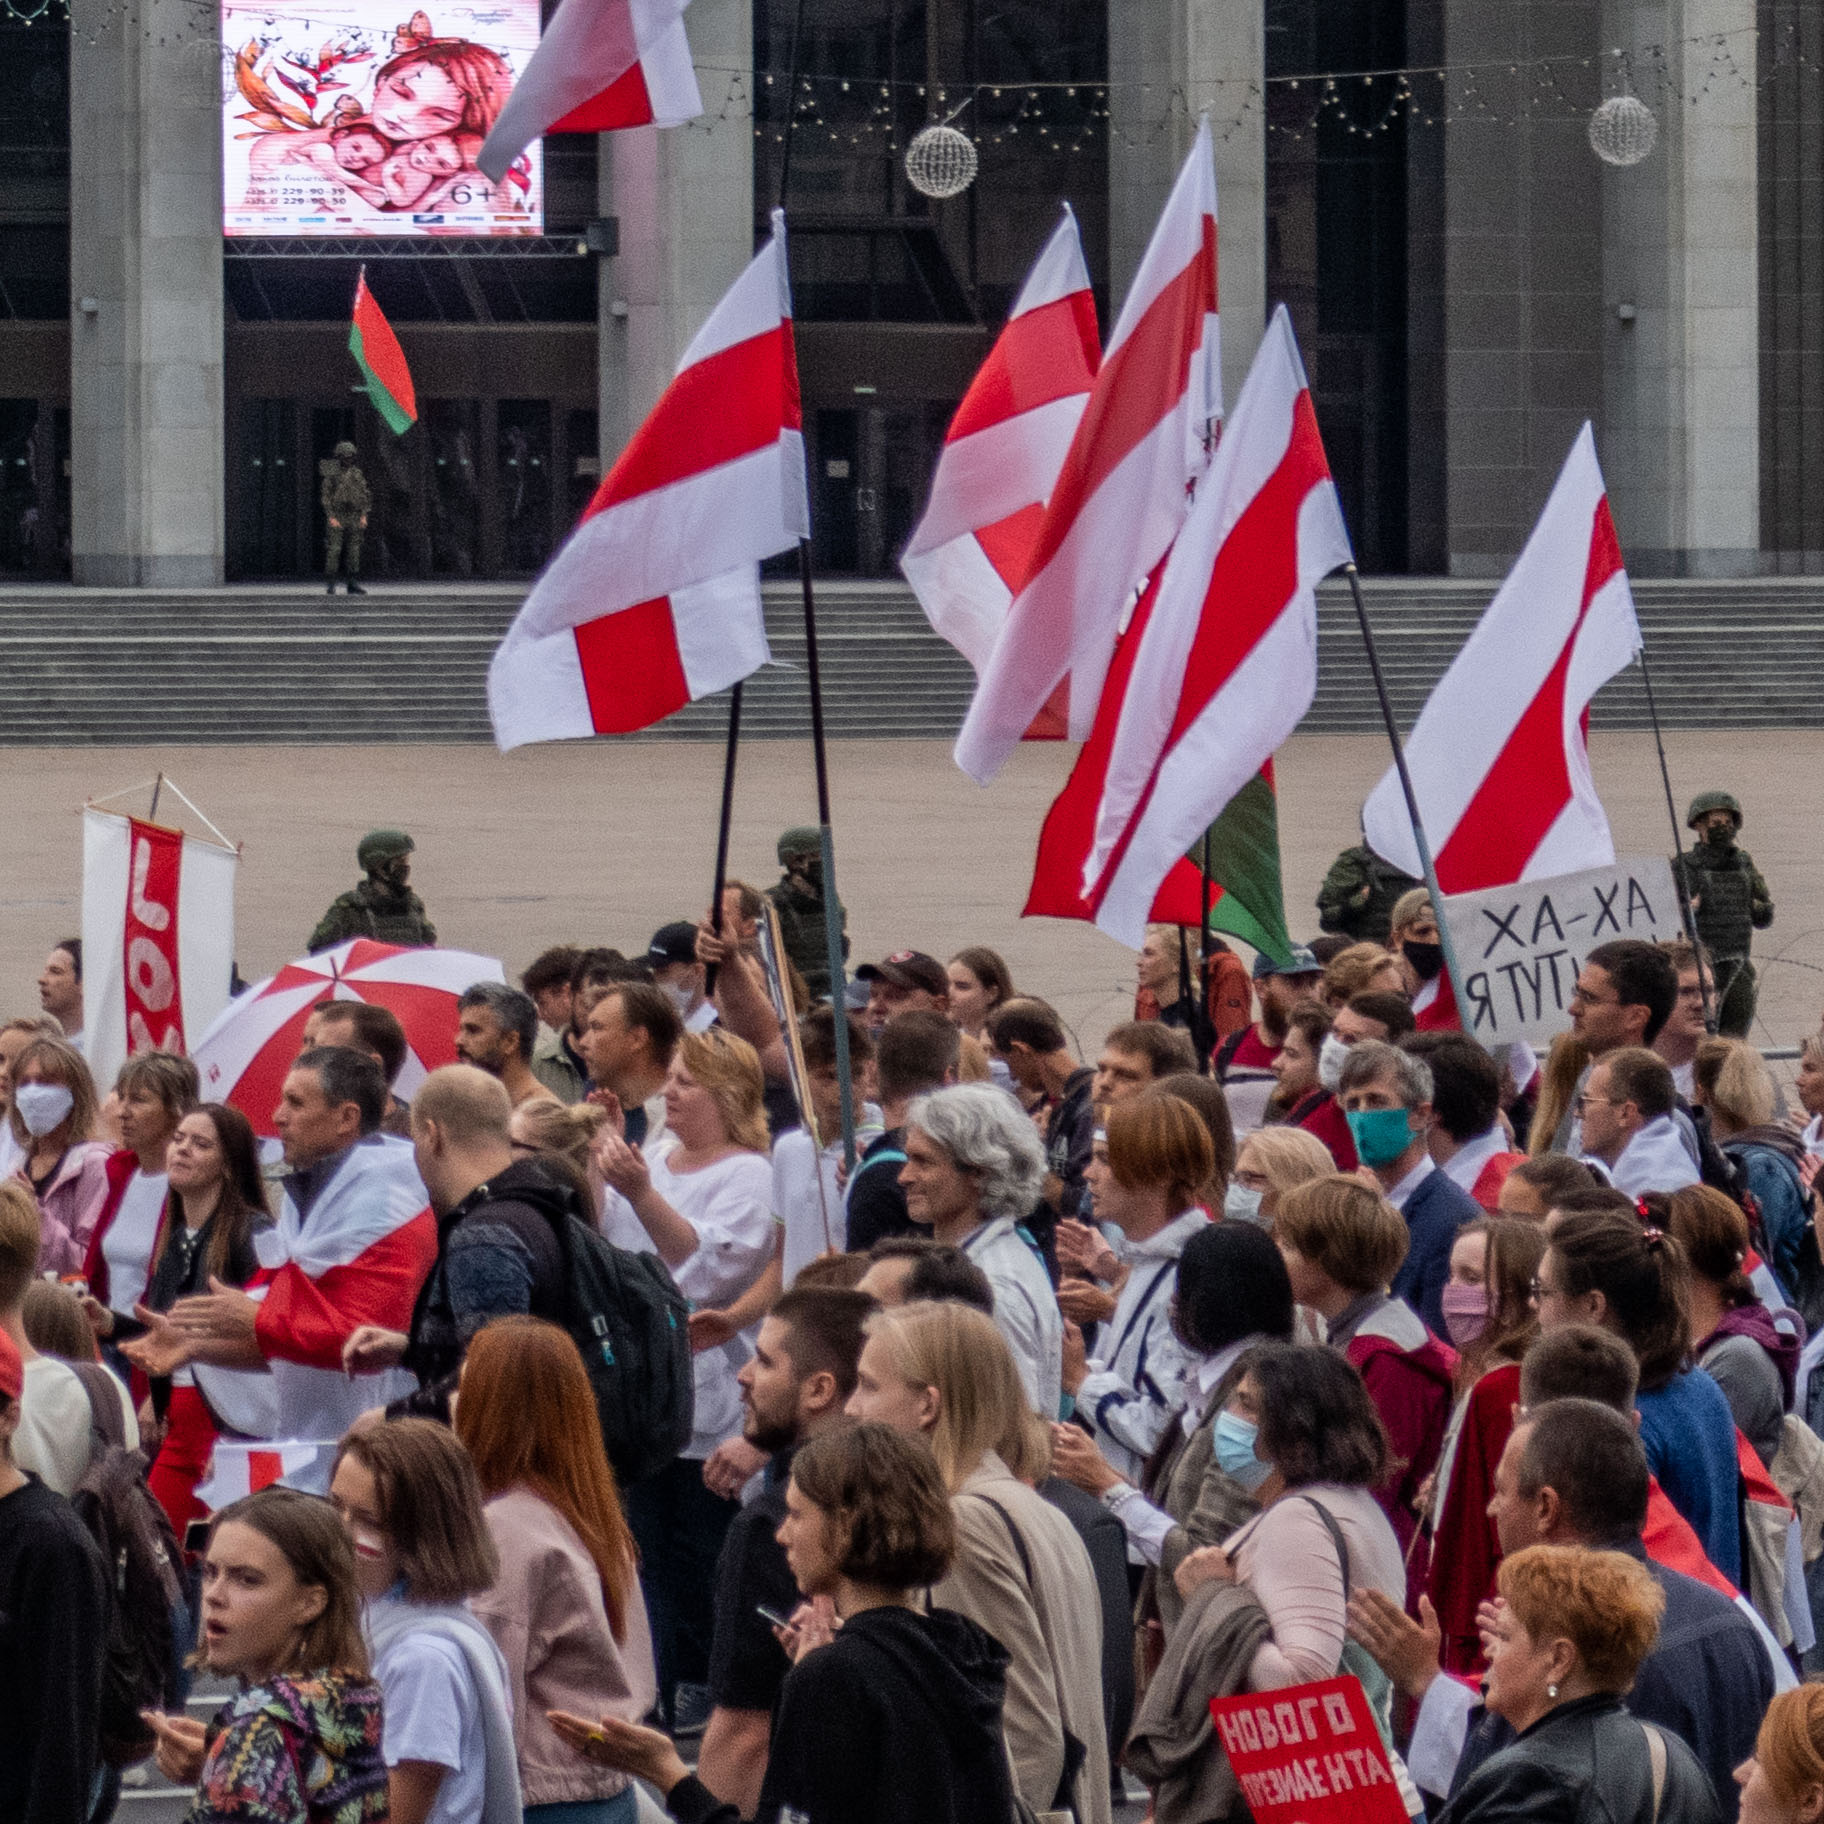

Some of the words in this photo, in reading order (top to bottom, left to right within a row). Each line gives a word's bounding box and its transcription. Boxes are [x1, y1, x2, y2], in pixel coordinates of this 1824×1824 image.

[451, 183, 498, 205] 6+
[1481, 876, 1657, 960] ХА-ХА
[1464, 971, 1498, 1032] Я
[1217, 1691, 1357, 1754] НОВОГО
[1239, 1745, 1394, 1808] ПРЕЗИДЕНТА
